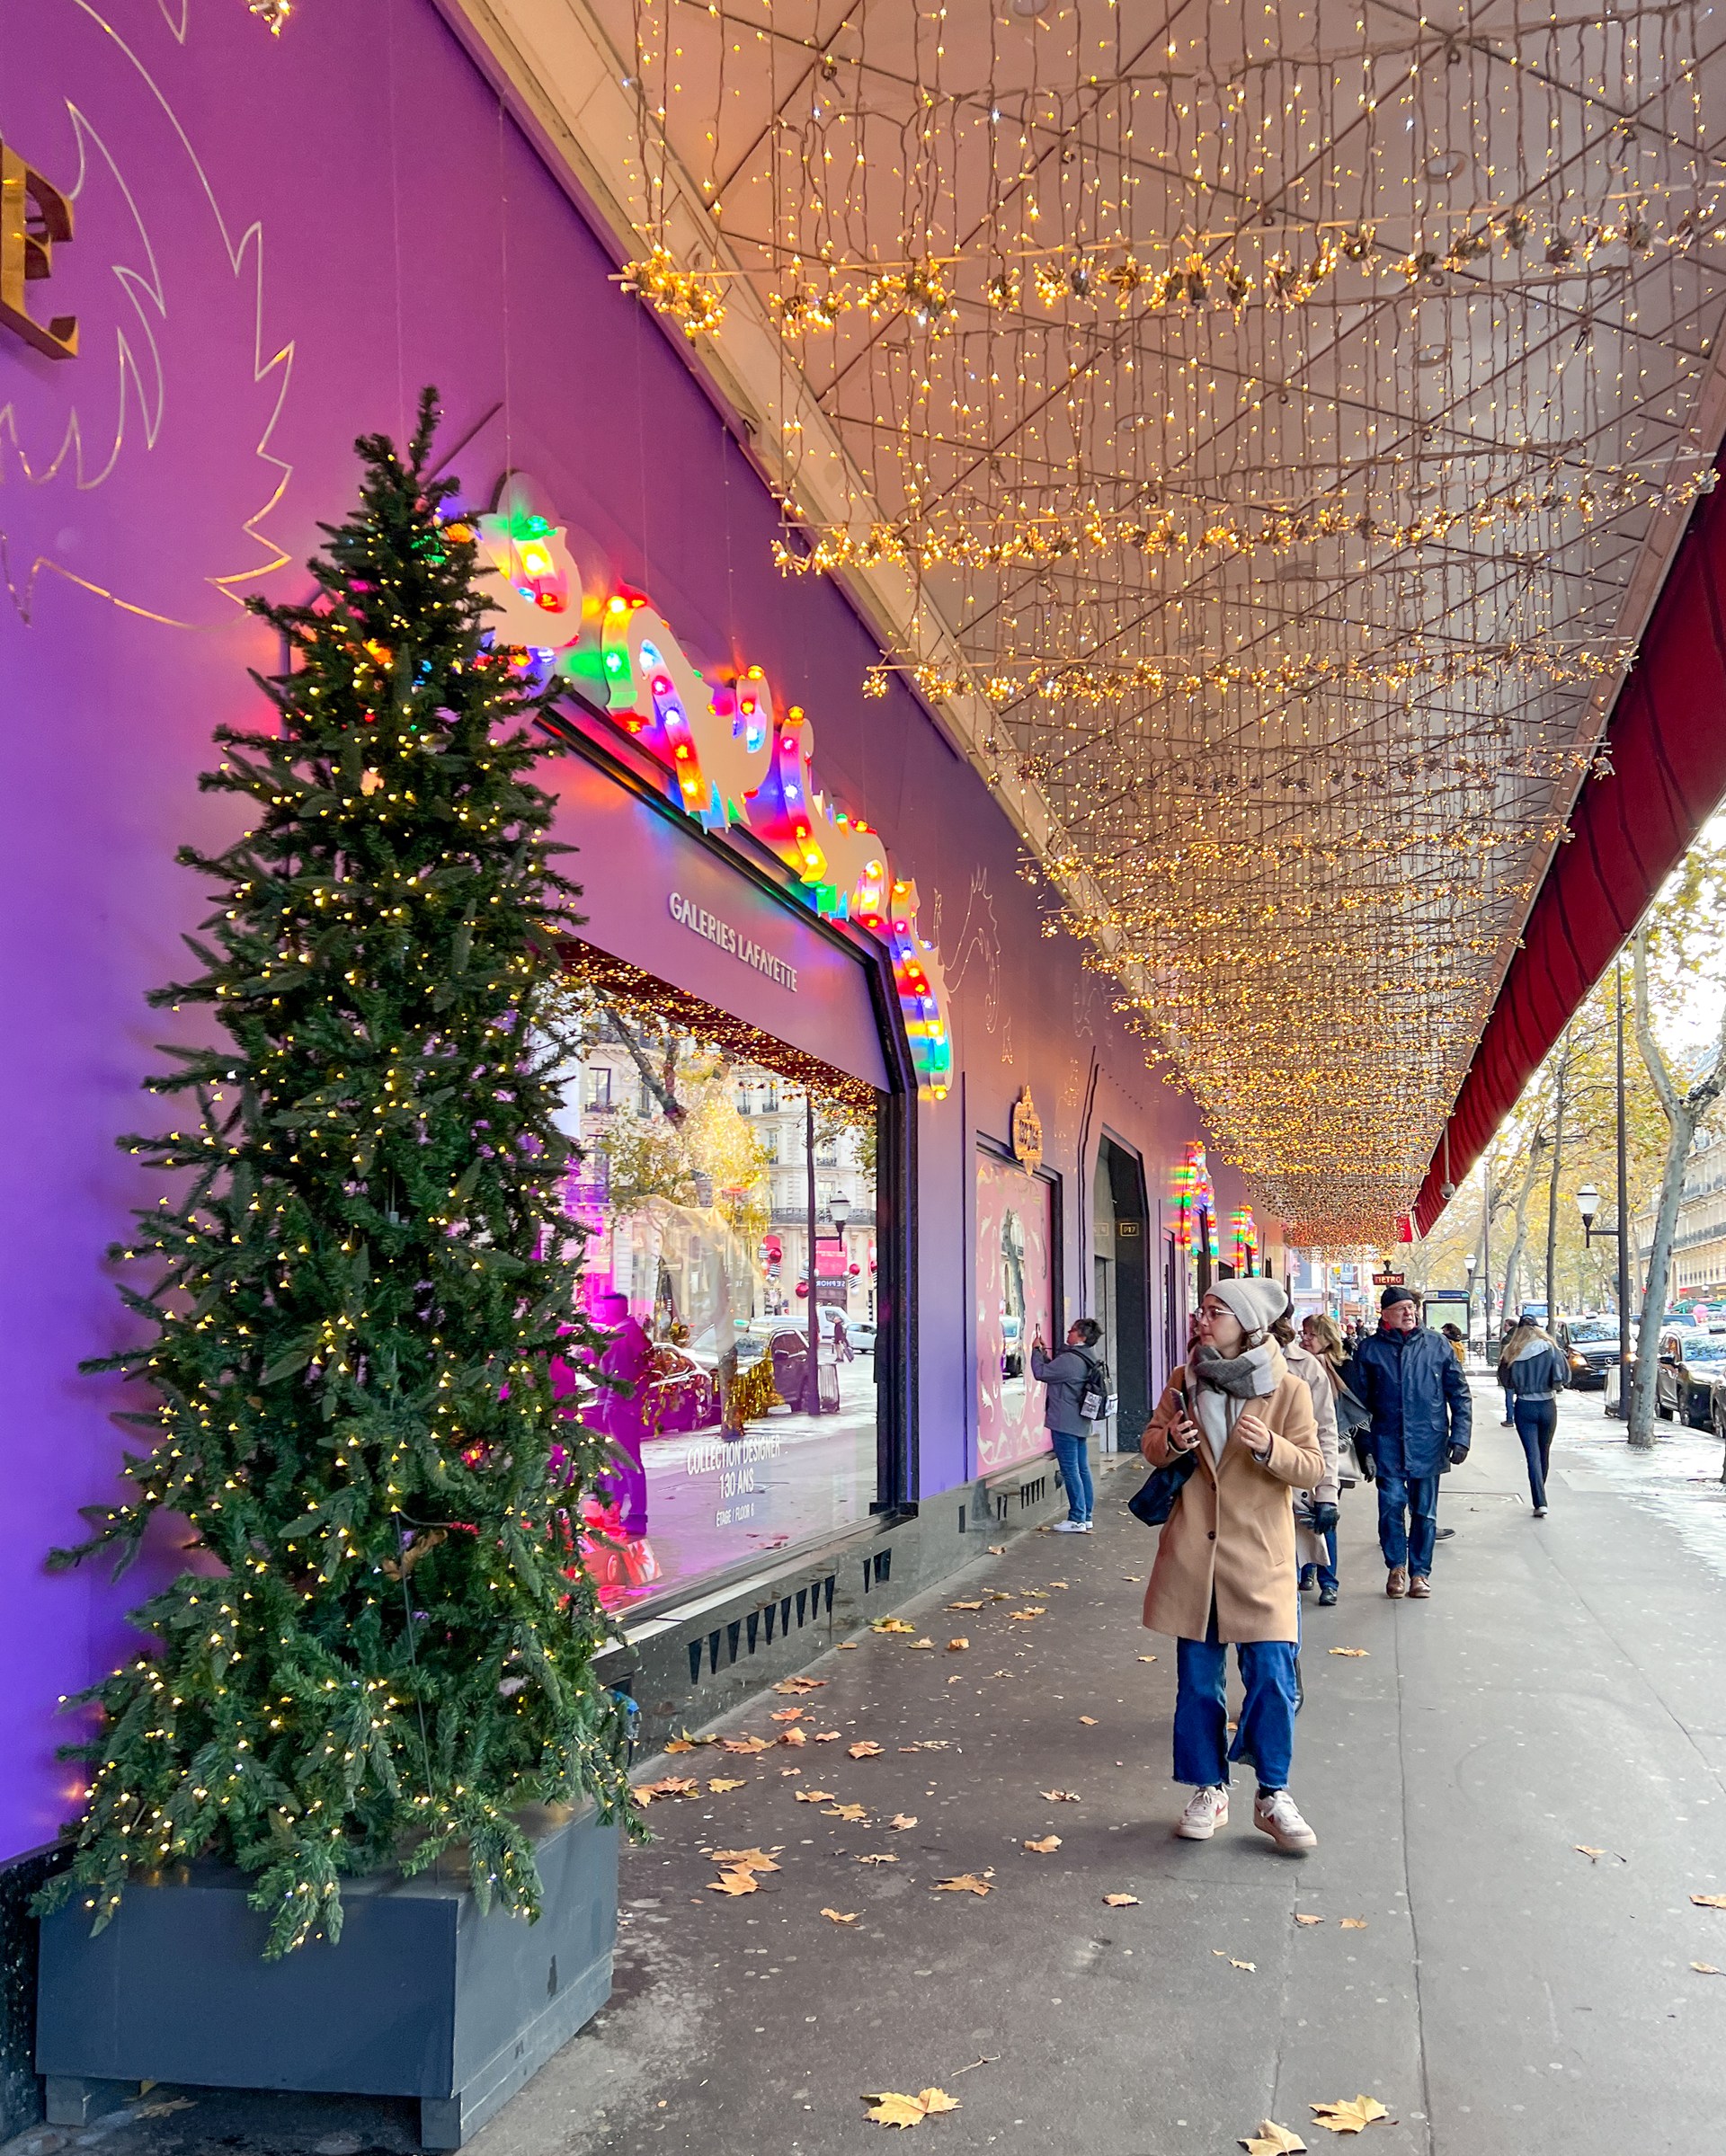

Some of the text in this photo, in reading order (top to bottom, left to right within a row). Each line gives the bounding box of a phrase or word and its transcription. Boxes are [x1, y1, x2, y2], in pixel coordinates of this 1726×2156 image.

[669, 892, 798, 993] GALERIES LAFAYETTE
[687, 1433, 780, 1476] COLLECTION DESIGNER
[720, 1468, 753, 1499] 130 ANS
[735, 1504, 750, 1522] FLOOR
